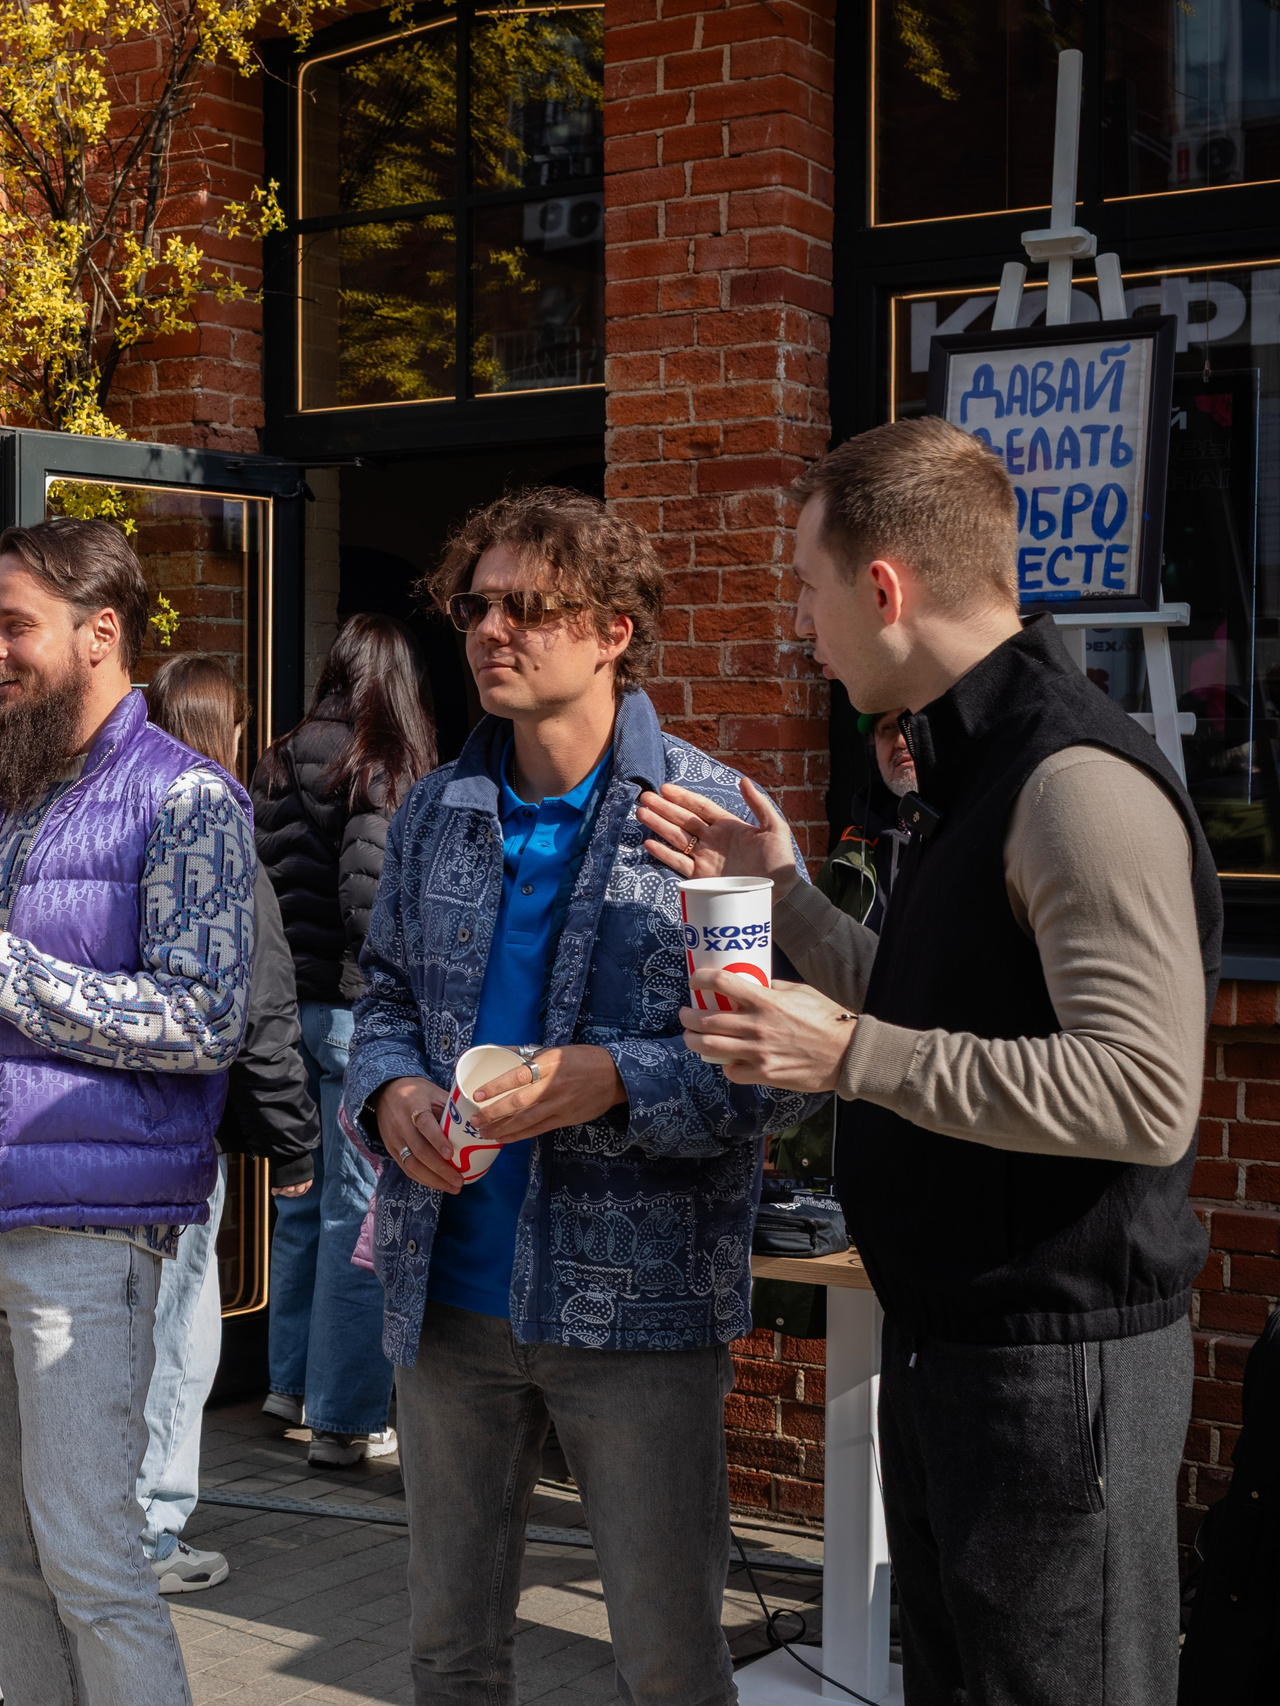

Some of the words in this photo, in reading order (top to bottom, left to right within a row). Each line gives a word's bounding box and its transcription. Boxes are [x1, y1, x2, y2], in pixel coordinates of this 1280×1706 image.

[960, 342, 1131, 424] ДАВАЙ
[703, 921, 770, 938] КОФЕ
[704, 936, 769, 951] ХАУЗ
